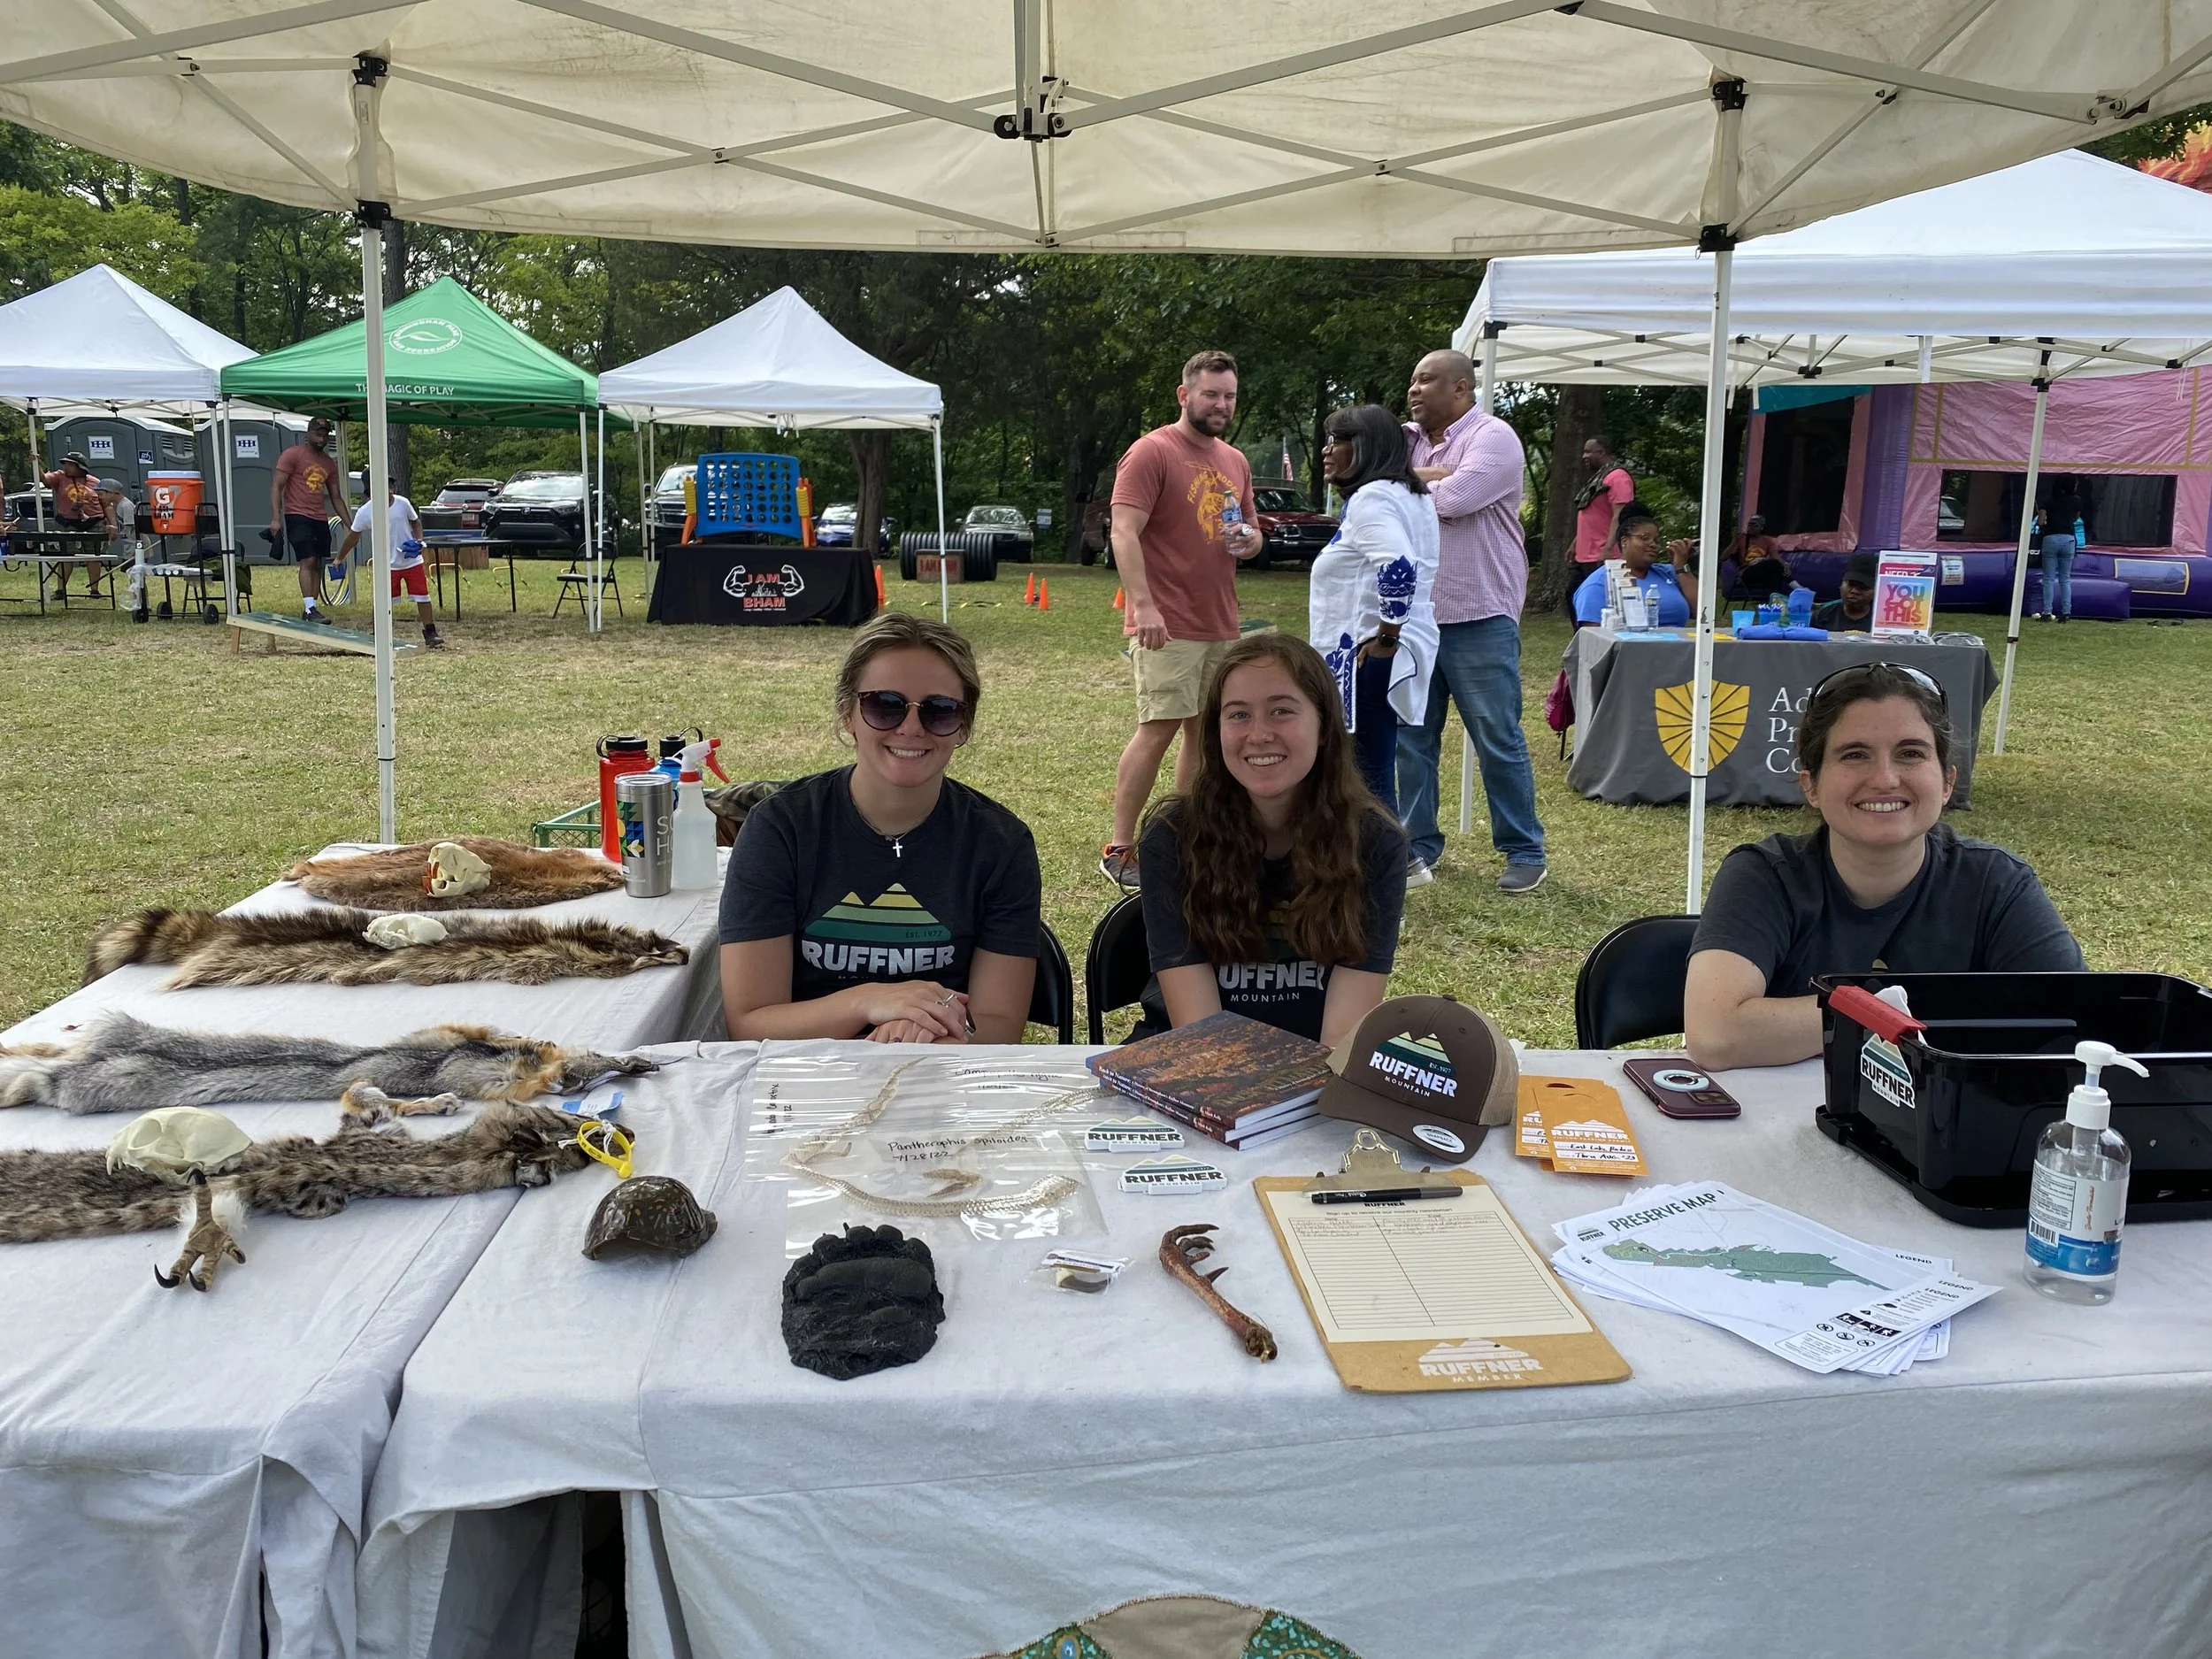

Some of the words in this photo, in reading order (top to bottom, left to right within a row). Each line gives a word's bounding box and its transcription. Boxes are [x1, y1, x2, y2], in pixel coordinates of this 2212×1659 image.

[356, 383, 367, 392] TH
[385, 384, 412, 394] AGIC
[413, 386, 427, 395] OF
[429, 386, 455, 396] PLAY
[1187, 471, 1209, 504] FISHING
[1216, 472, 1240, 498] RODEO
[748, 573, 753, 584] I
[755, 573, 780, 584] AM
[1886, 585, 1925, 601] YOU
[743, 597, 786, 609] BHAM
[1884, 606, 1922, 623] THIS
[802, 940, 956, 975] RUFFNER
[1231, 993, 1300, 1002] MOUNTAIN
[1369, 1050, 1458, 1097] RUFFNER
[1385, 1076, 1431, 1097] MOUNTAIN
[1862, 1057, 1914, 1107] RUFFNER
[1088, 1133, 1182, 1141] RUFFNER
[1551, 1129, 1630, 1141] RUFFNER
[887, 1138, 967, 1152] Pantherophis
[973, 1135, 1028, 1146] spiloides
[1125, 1171, 1223, 1183] RUFFNER
[1608, 1202, 1686, 1232] PRESERVE
[1681, 1193, 1717, 1210] MAP
[1895, 1254, 1932, 1264] LEGEND
[1938, 1280, 1974, 1291] LEGEND
[1924, 1287, 1960, 1299] LEGEND
[1419, 1358, 1544, 1377] RUFFNER
[1452, 1373, 1524, 1383] MEMBER
